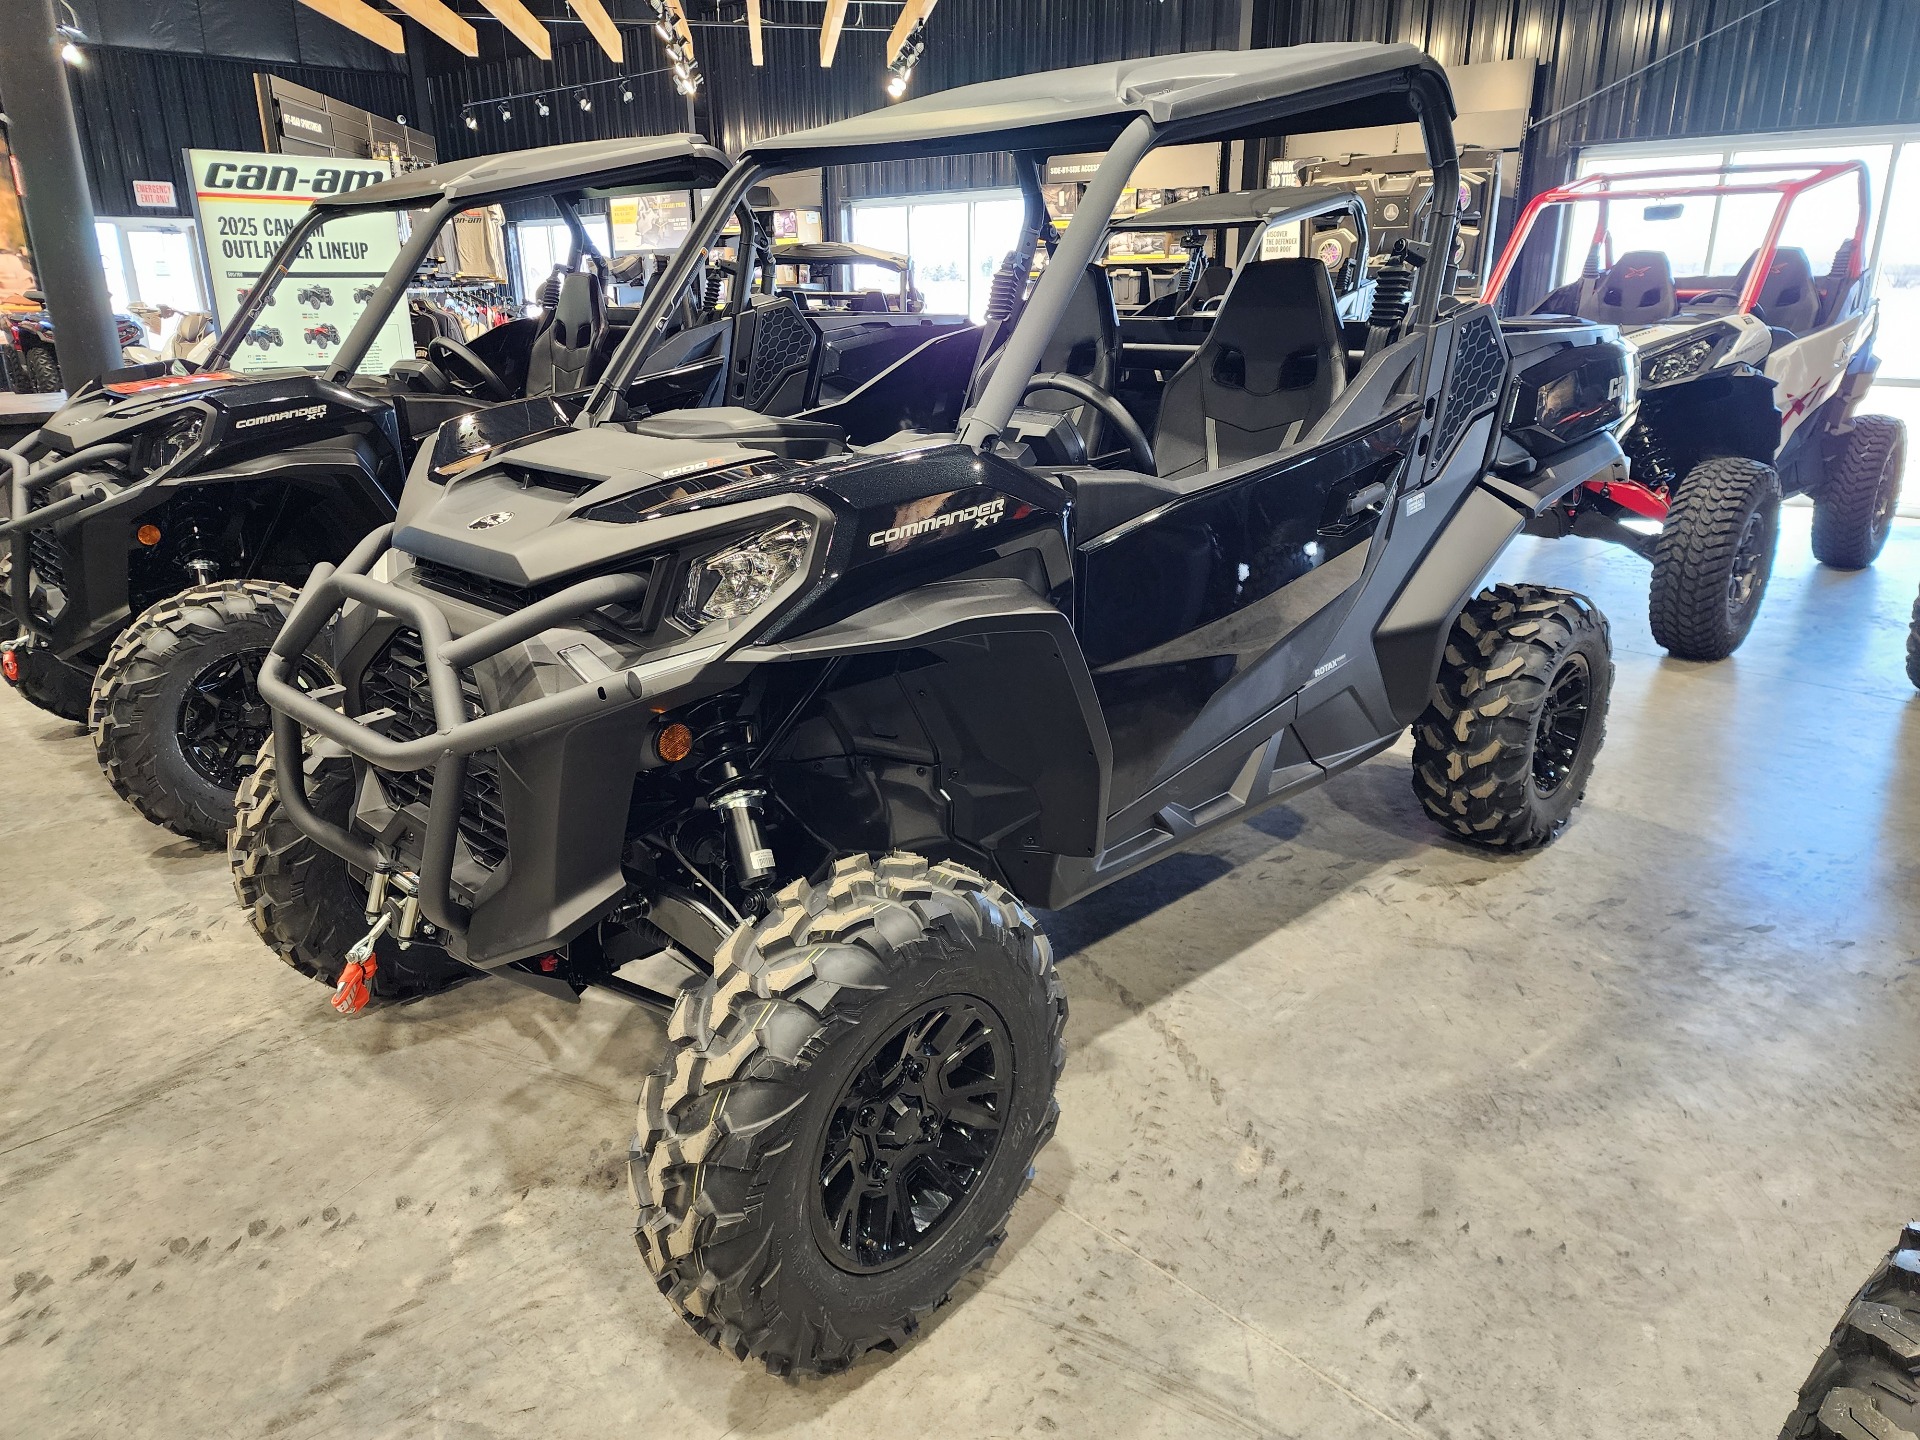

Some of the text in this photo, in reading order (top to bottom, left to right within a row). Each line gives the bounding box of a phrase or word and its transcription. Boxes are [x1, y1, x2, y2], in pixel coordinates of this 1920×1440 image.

[1050, 165, 1080, 175] SIDE-BY-SIDE
[1271, 160, 1294, 175] WORK
[204, 162, 384, 193] can-am
[1270, 173, 1297, 187] TO THE
[136, 184, 171, 194] EMERGENCY
[141, 194, 170, 204] EXIT ONLY
[218, 216, 325, 237] 2025 CANM
[222, 239, 369, 260] OUTLANER LINEUP
[235, 404, 327, 429] COMMANDER
[306, 412, 326, 421] XT
[662, 457, 726, 478] 1000R
[869, 498, 1005, 547] COMMANDER
[974, 511, 1004, 529] XT
[1314, 659, 1338, 678] ROTAX
